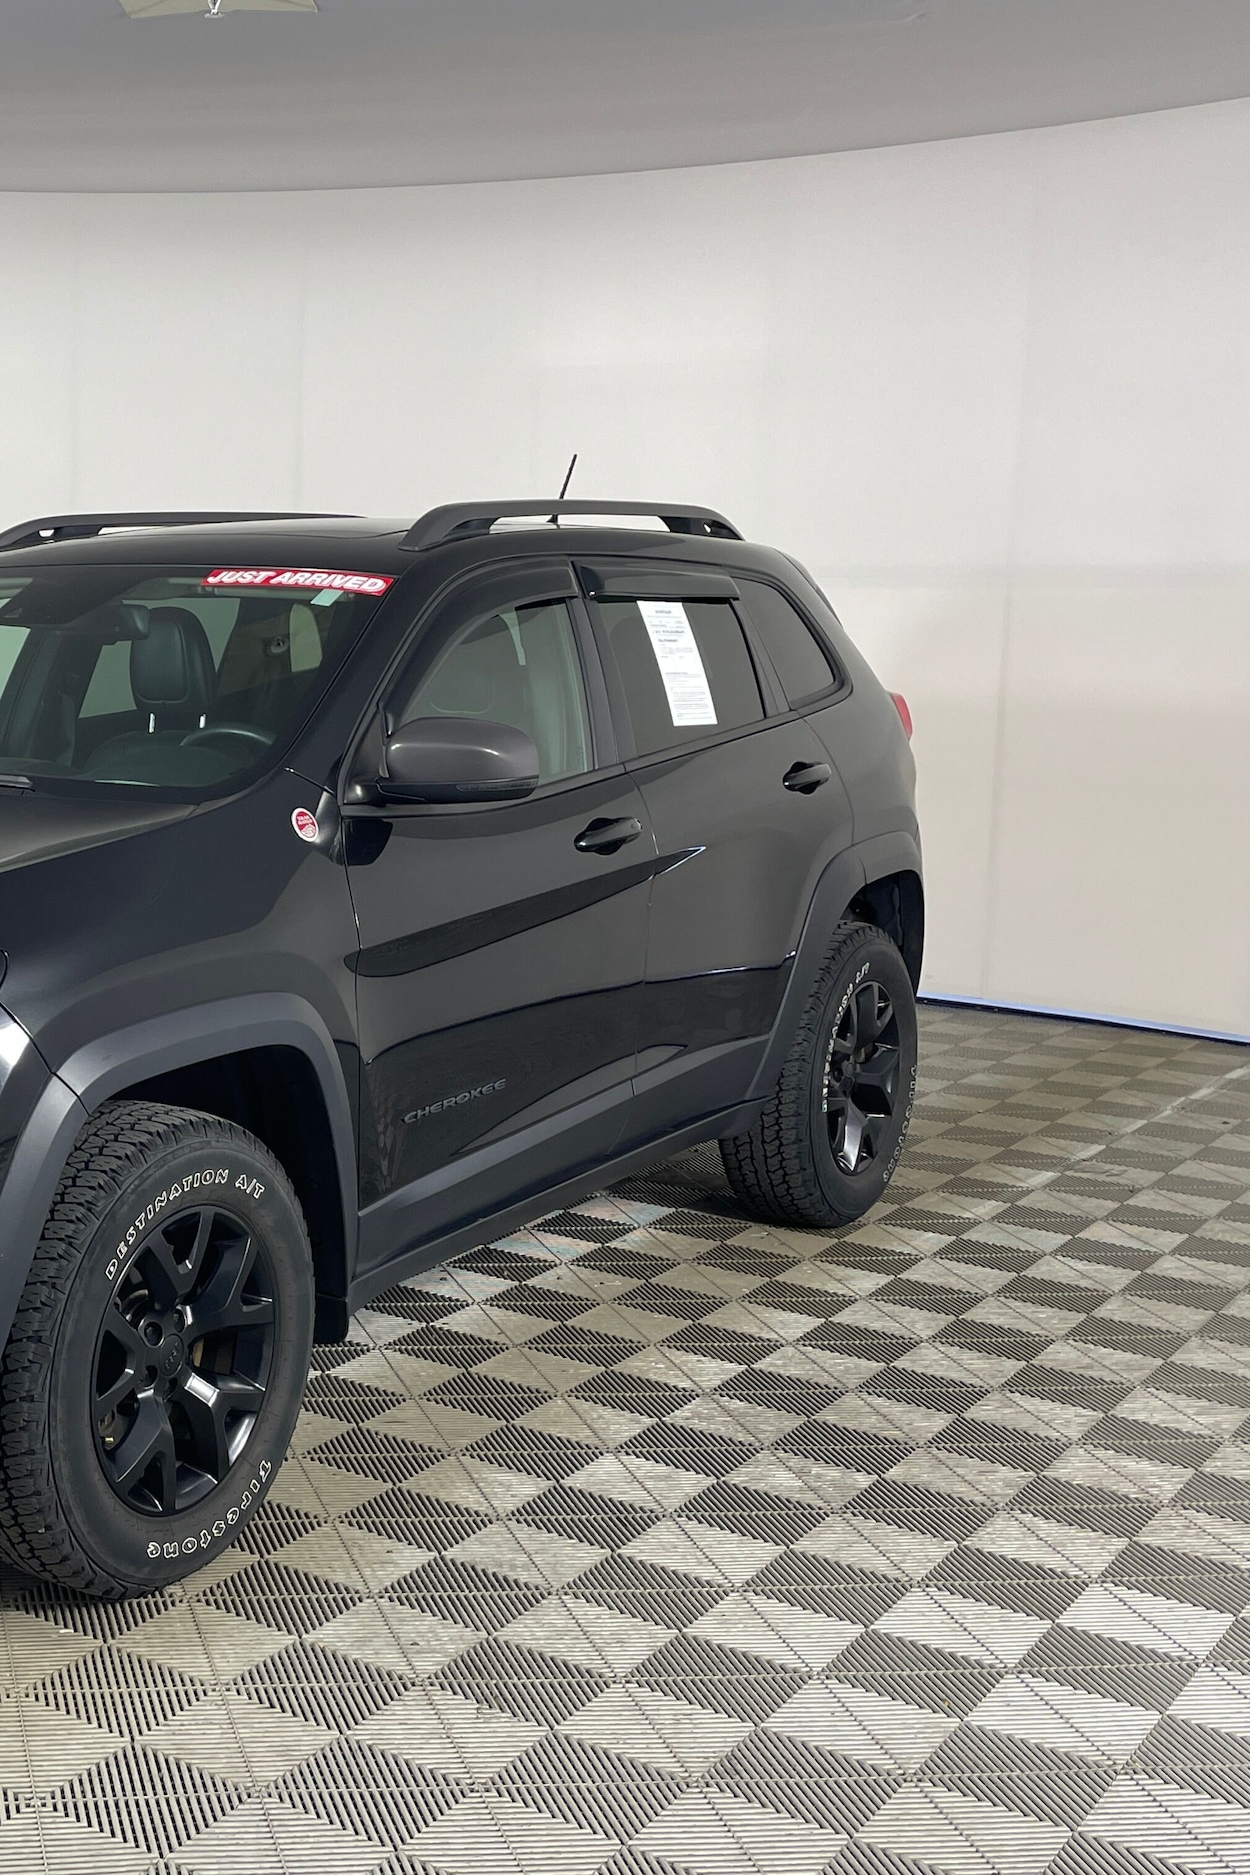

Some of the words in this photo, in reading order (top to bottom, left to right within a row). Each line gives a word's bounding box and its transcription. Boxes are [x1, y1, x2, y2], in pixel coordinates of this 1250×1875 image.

[207, 570, 273, 584] JUST
[270, 572, 387, 592] ARRIVED
[403, 1078, 507, 1124] CHEROKEE
[105, 1168, 230, 1281] DESTINATION
[234, 1173, 266, 1200] A/T
